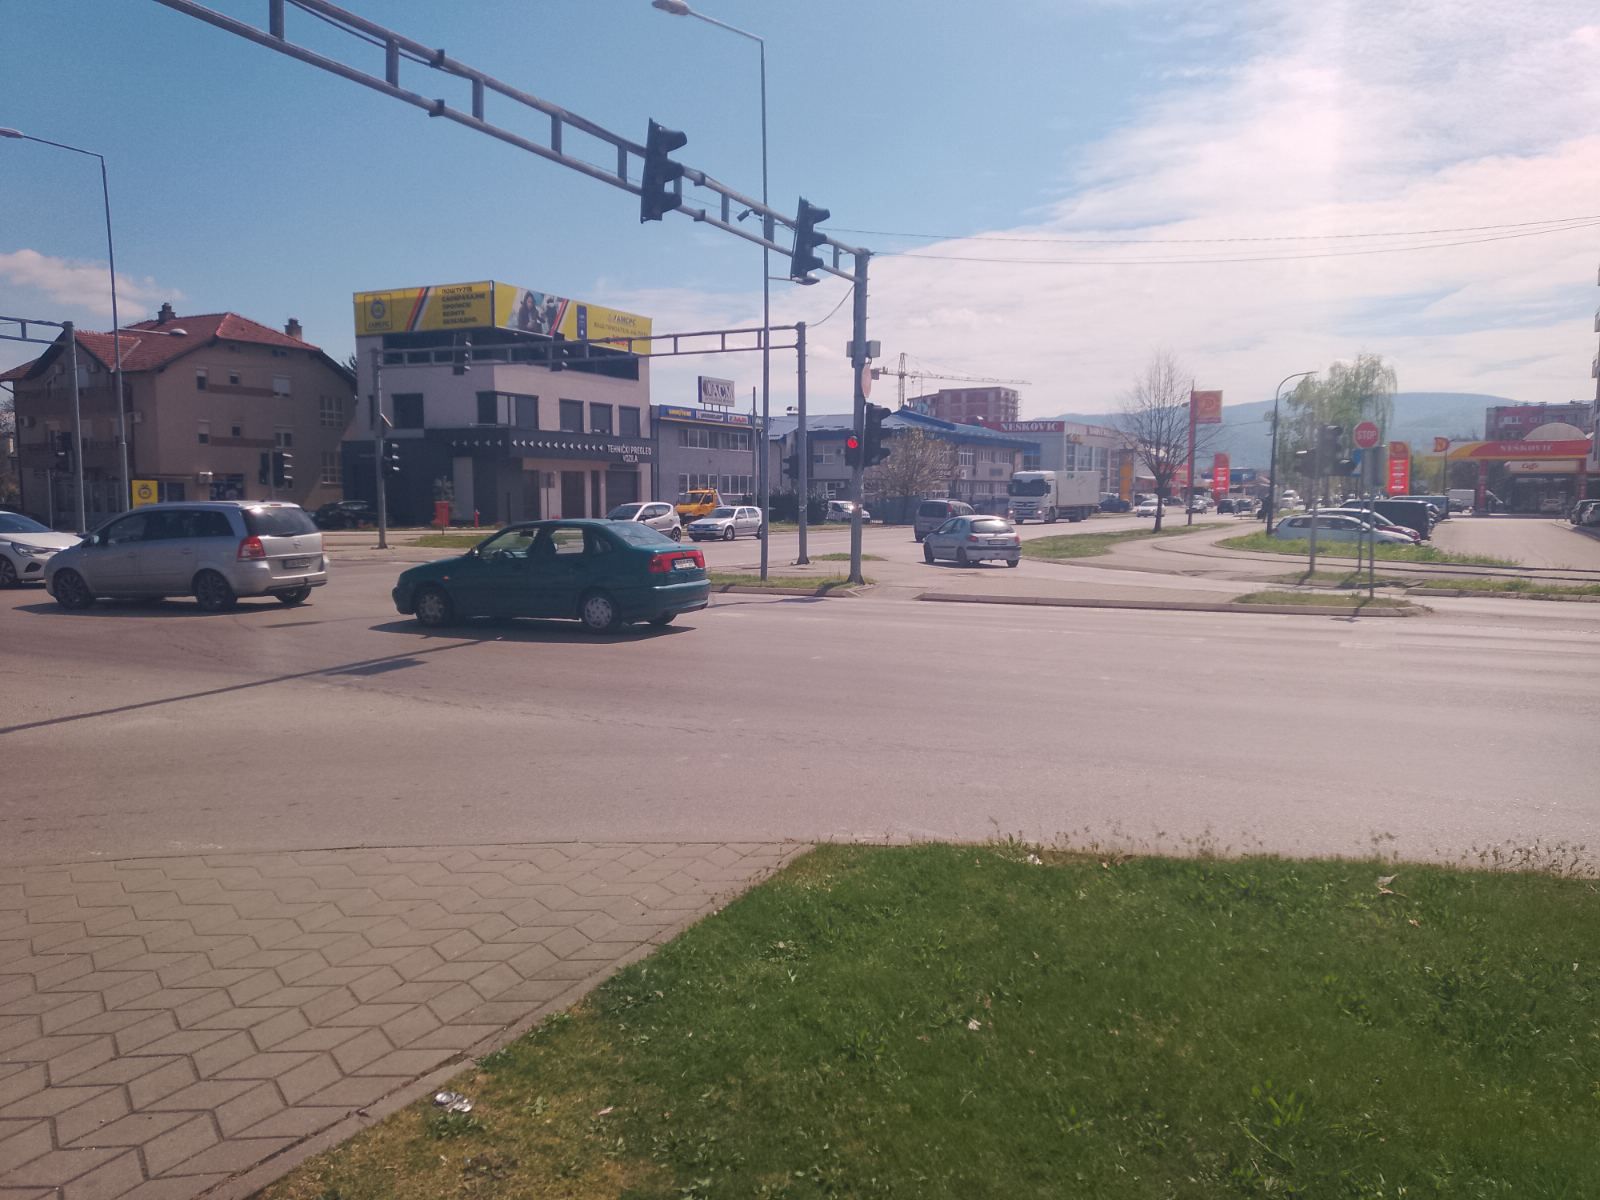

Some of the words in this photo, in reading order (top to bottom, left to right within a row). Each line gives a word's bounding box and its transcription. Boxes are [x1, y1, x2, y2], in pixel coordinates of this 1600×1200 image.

[1357, 430, 1377, 440] STOP
[607, 443, 630, 454] TEHNIČKI
[630, 446, 652, 456] PREGLED
[623, 454, 638, 463] VOZILA
